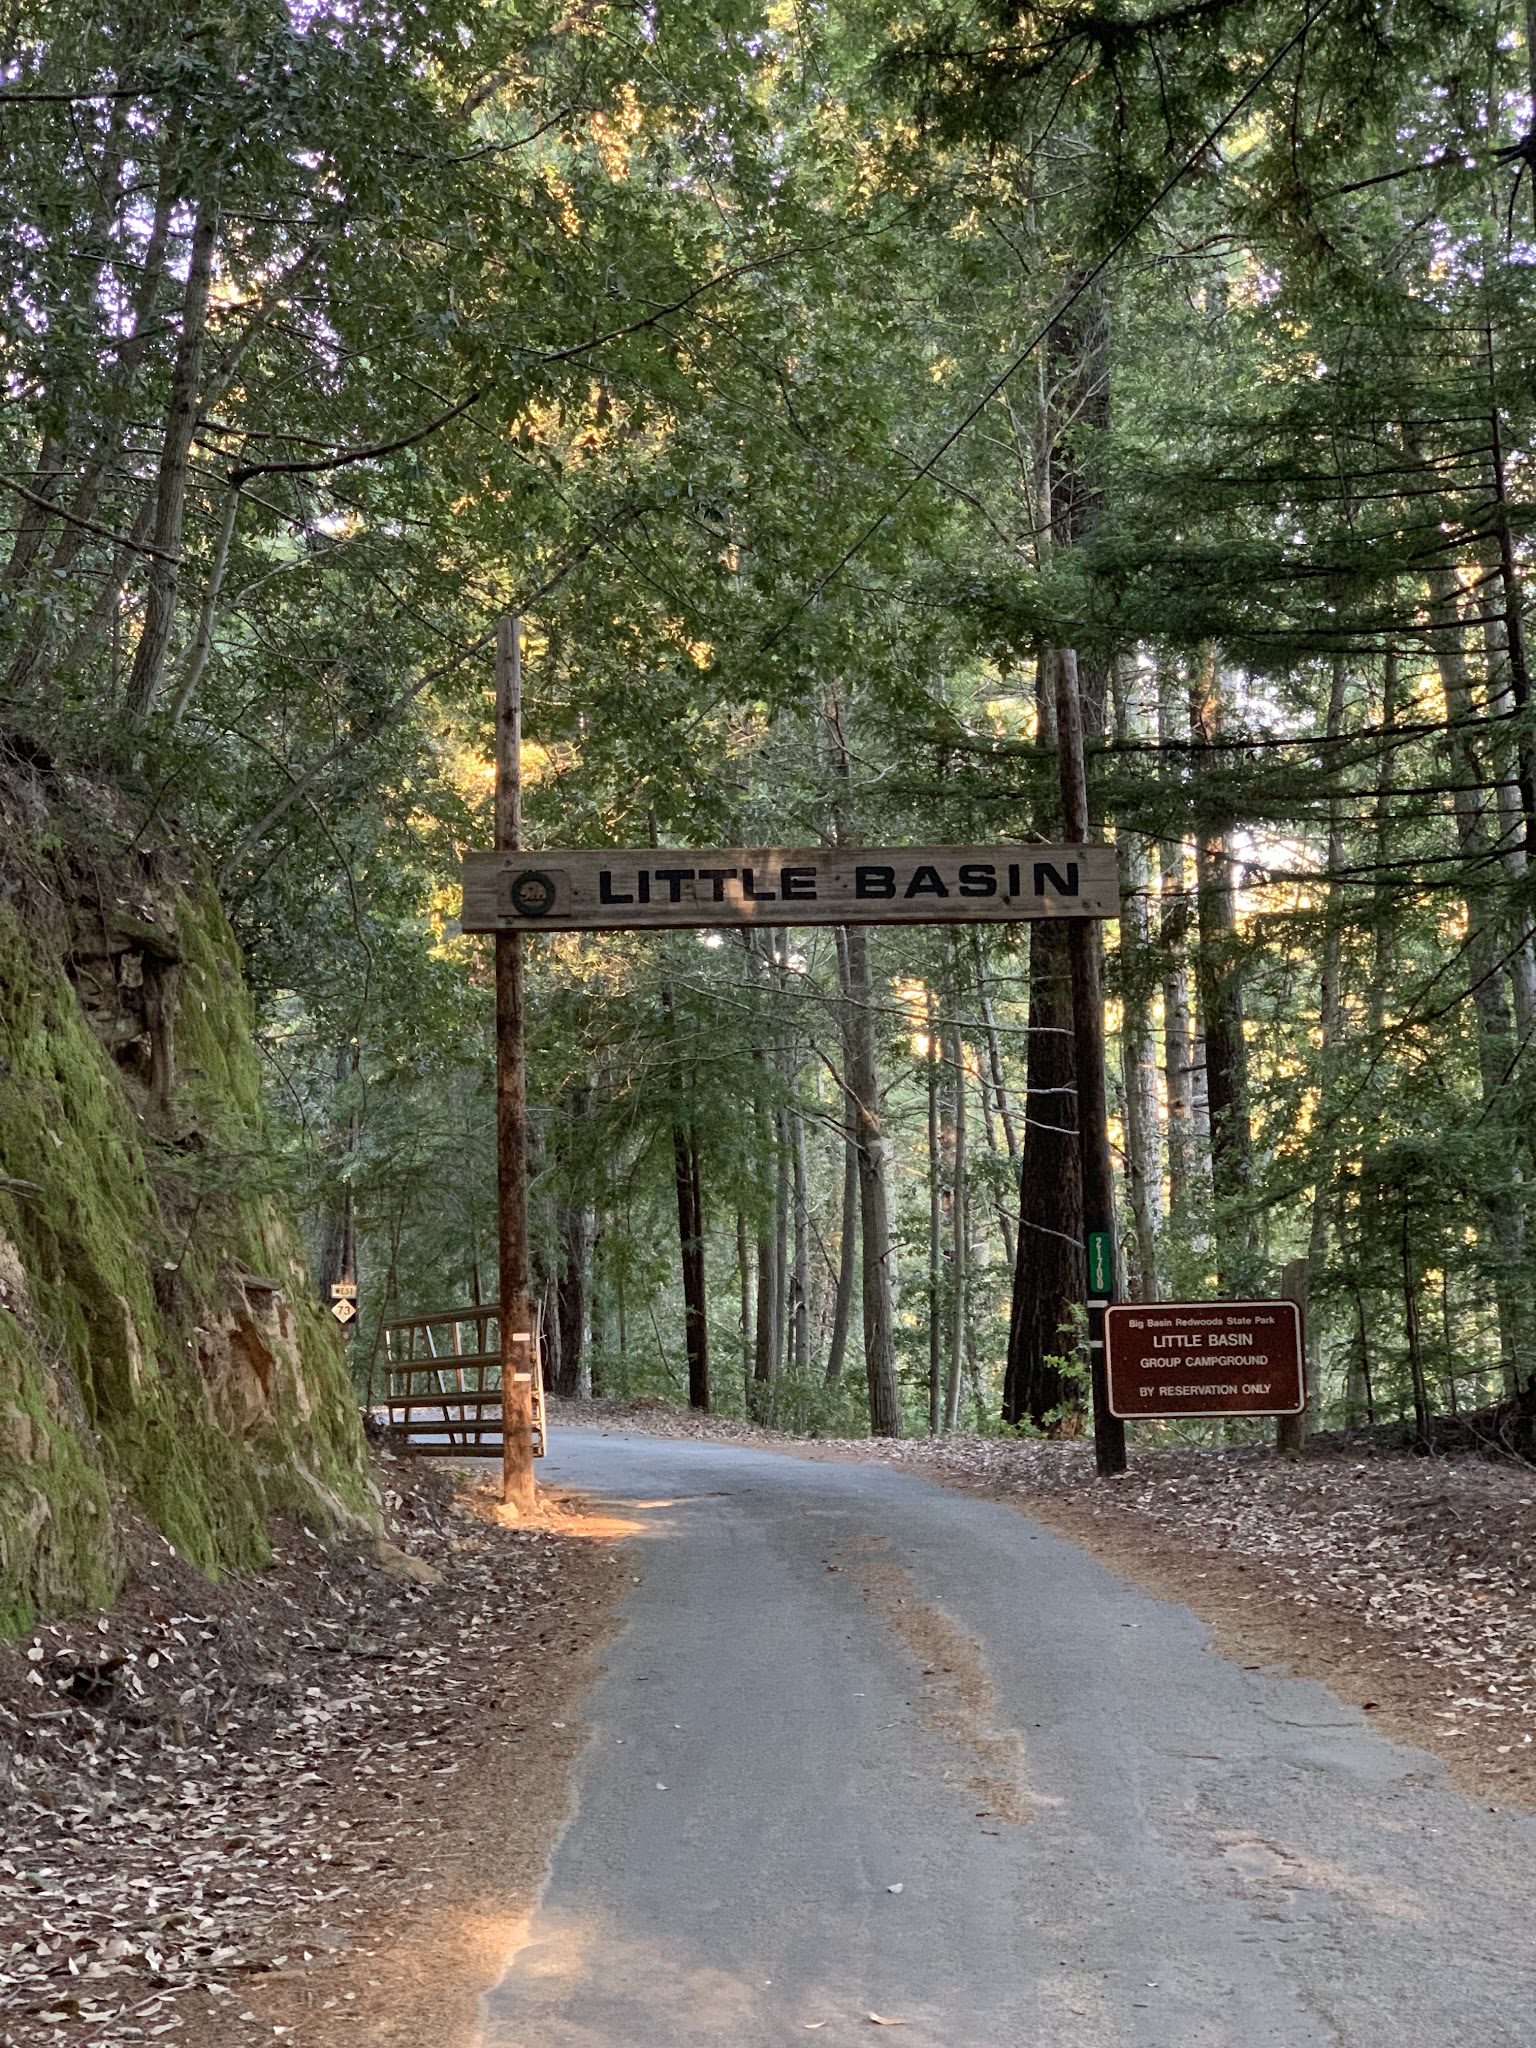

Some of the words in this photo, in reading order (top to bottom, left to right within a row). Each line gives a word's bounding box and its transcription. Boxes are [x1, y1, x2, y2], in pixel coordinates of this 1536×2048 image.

[598, 867, 818, 905] LITTLE
[855, 862, 1079, 900] BASIN
[335, 1287, 353, 1295] WEST
[337, 1306, 351, 1316] 73
[1129, 1319, 1144, 1330] Big
[1147, 1318, 1172, 1328] Basin
[1175, 1317, 1223, 1327] Redwoods
[1226, 1316, 1252, 1326] State
[1255, 1316, 1276, 1325] Park
[1153, 1334, 1202, 1348] LITTLE
[1208, 1333, 1253, 1347] BASIN
[1140, 1357, 1181, 1369] GROUP
[1185, 1355, 1268, 1368] CAMPGROUND
[1139, 1386, 1154, 1397] BY
[1159, 1384, 1238, 1397] RESERVATION
[1242, 1384, 1272, 1395] ONLY
